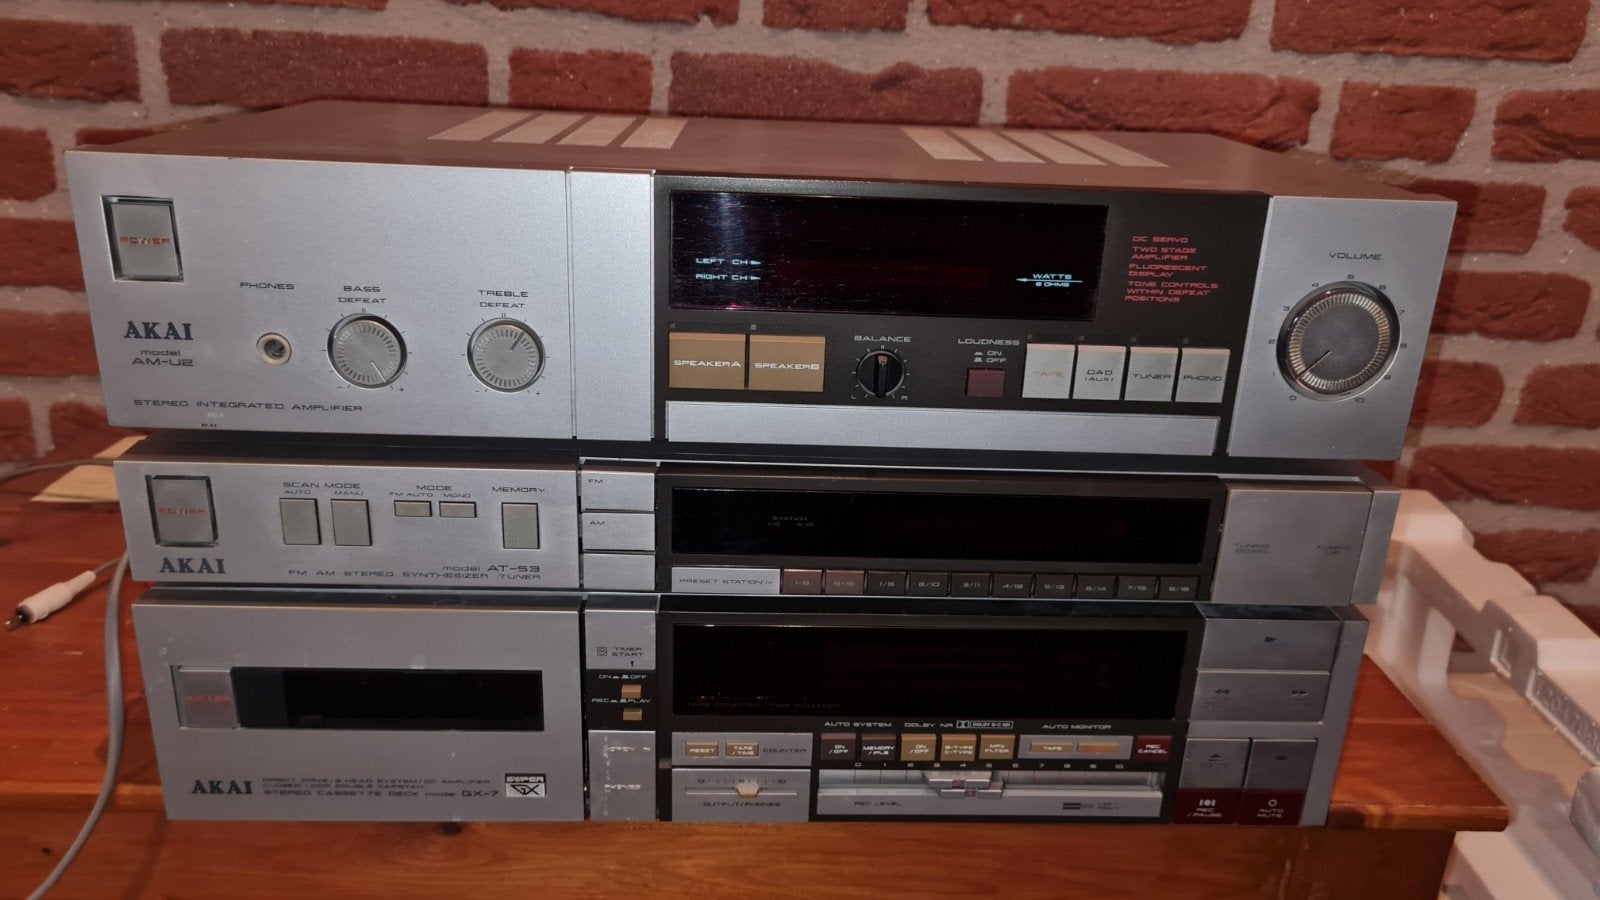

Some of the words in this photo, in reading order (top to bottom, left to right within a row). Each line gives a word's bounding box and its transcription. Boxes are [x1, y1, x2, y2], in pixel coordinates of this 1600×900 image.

[119, 236, 173, 246] POWER
[1329, 252, 1382, 260] VOLUME
[1128, 263, 1208, 272] FLUORESCENT
[240, 281, 295, 290] PHONES
[477, 290, 529, 298] TREBLE
[124, 320, 194, 341] AKAI
[854, 335, 912, 343] BALANCE
[131, 357, 194, 367] AM-U2
[134, 399, 188, 407] STEREO
[196, 401, 284, 410] INTEGRATED
[291, 403, 363, 412] AMPLIFIER
[159, 557, 226, 574] AKAI
[191, 780, 254, 794] AKAI
[510, 784, 541, 796] GX
